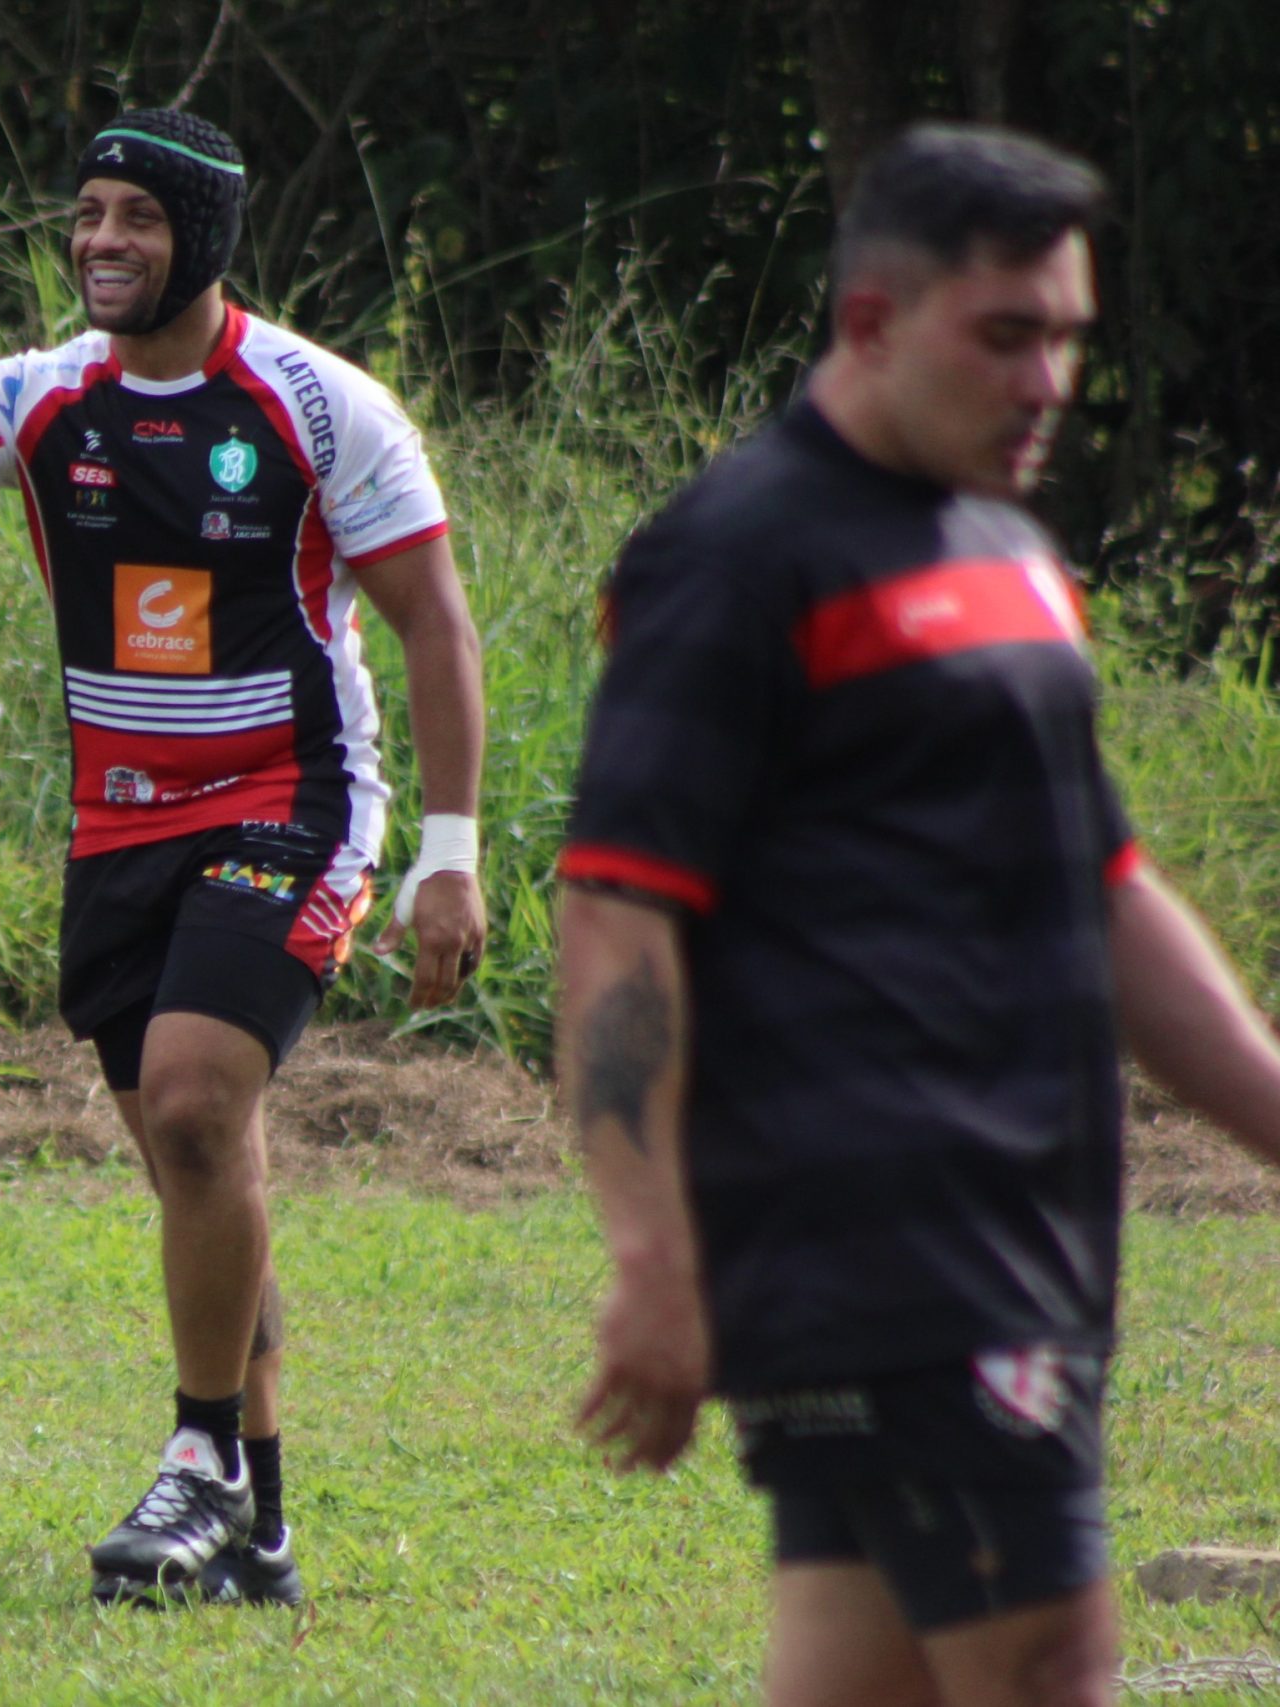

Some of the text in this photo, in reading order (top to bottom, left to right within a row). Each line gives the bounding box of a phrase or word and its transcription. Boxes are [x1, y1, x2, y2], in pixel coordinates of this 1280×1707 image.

[133, 421, 183, 436] CNA
[72, 467, 114, 485] SESI
[127, 632, 196, 651] cebrace
